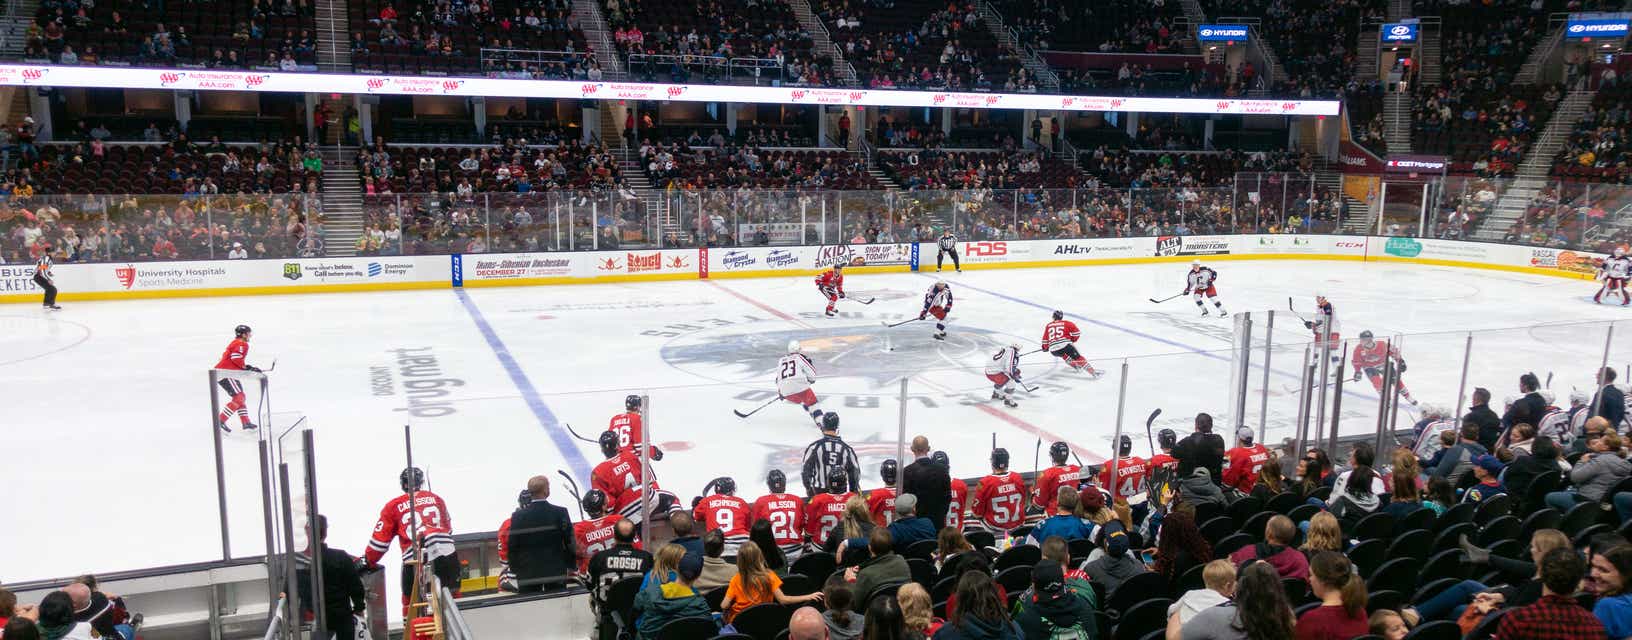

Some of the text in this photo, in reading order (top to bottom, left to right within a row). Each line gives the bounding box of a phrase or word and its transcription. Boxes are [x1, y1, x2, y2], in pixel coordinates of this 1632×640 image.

[1586, 24, 1628, 32] HYUNDAI
[188, 72, 206, 80] Auto
[1387, 160, 1414, 168] ROCKET
[823, 245, 846, 258] KID
[865, 246, 884, 254] SIGN
[966, 242, 1008, 256] HDS
[722, 253, 748, 264] Diamond
[766, 252, 792, 263] Diamond
[777, 256, 798, 267] Crystal
[820, 254, 851, 266] NATION
[866, 252, 890, 261] TODAY!
[734, 258, 756, 268] Crystal
[138, 267, 226, 278] University Hospitals
[1048, 326, 1064, 338] 25
[781, 360, 796, 380] 23
[828, 452, 837, 464] 5
[1120, 475, 1146, 496] 44
[709, 500, 741, 509] HIGHMORE
[768, 501, 796, 510] NILSSON
[992, 493, 1022, 524] 57
[716, 508, 733, 532] 9
[770, 510, 798, 539] 21
[606, 556, 644, 570] CROSBY
